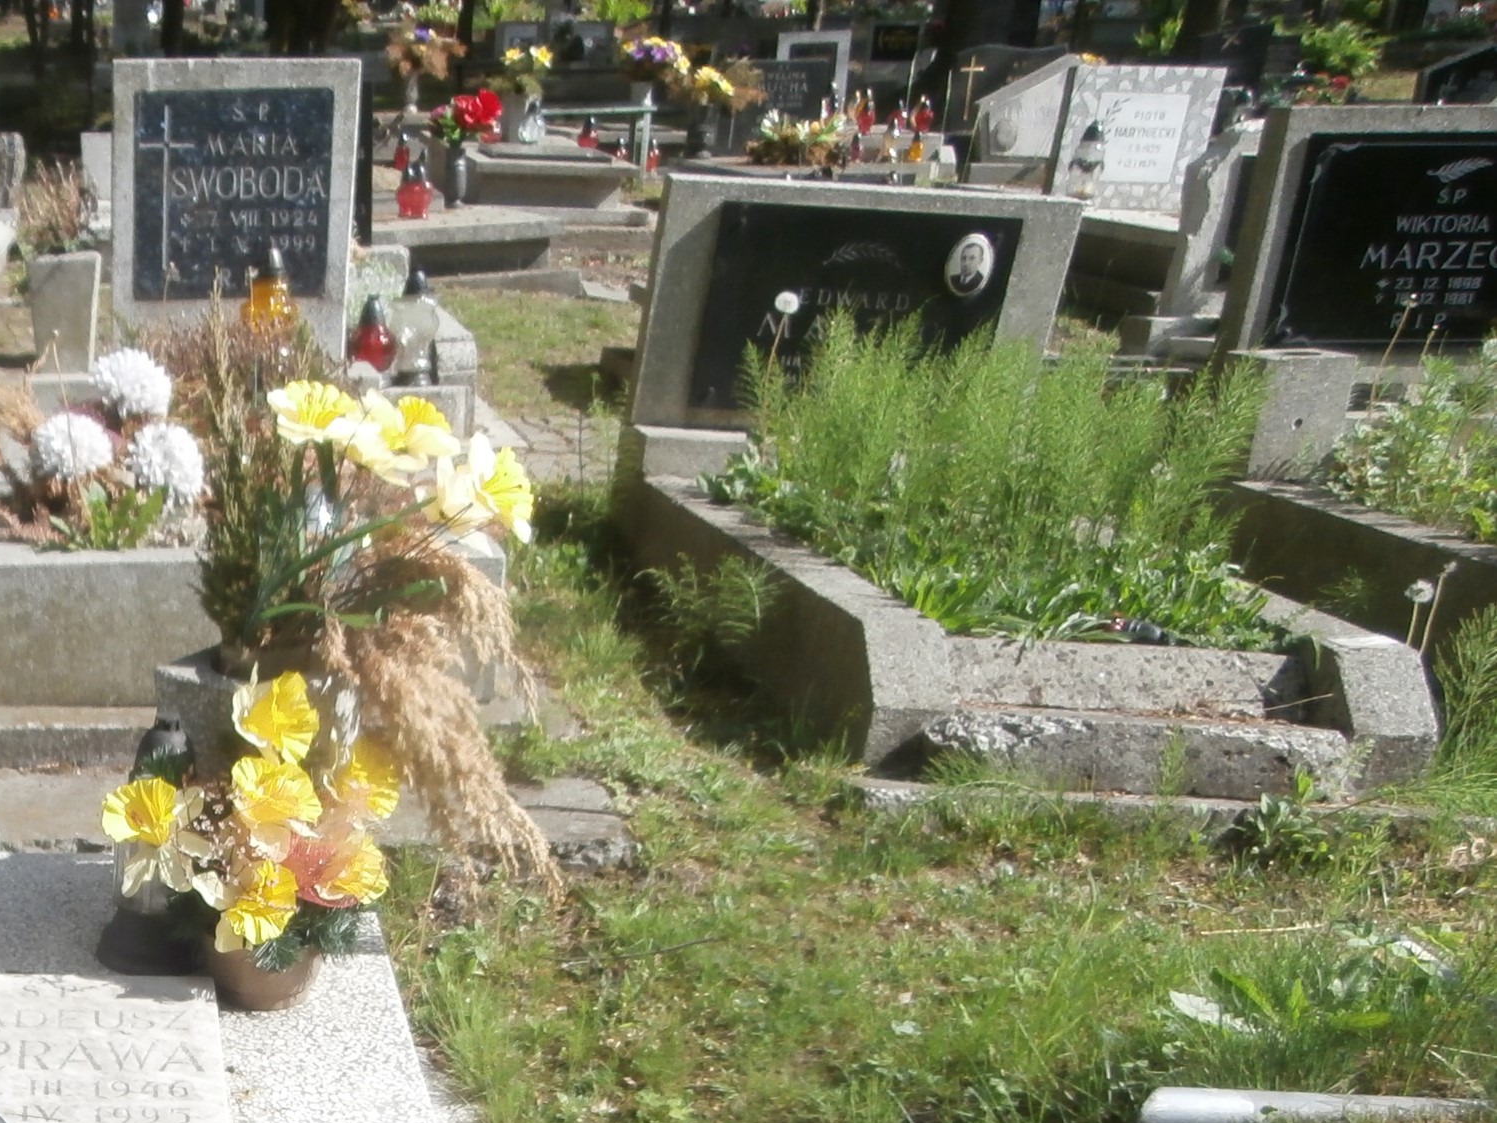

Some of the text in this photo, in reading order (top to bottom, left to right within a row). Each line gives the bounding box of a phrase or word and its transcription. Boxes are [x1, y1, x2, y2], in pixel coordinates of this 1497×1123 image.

[1133, 110, 1167, 121] PIOTR
[204, 132, 299, 156] MARIA
[171, 166, 327, 201] SWOBODA
[270, 210, 319, 227] 1924
[1396, 214, 1491, 234] WIKTORIA
[269, 234, 317, 251] 1999
[798, 287, 911, 311] EDWARD
[93, 1079, 191, 1099] 1946
